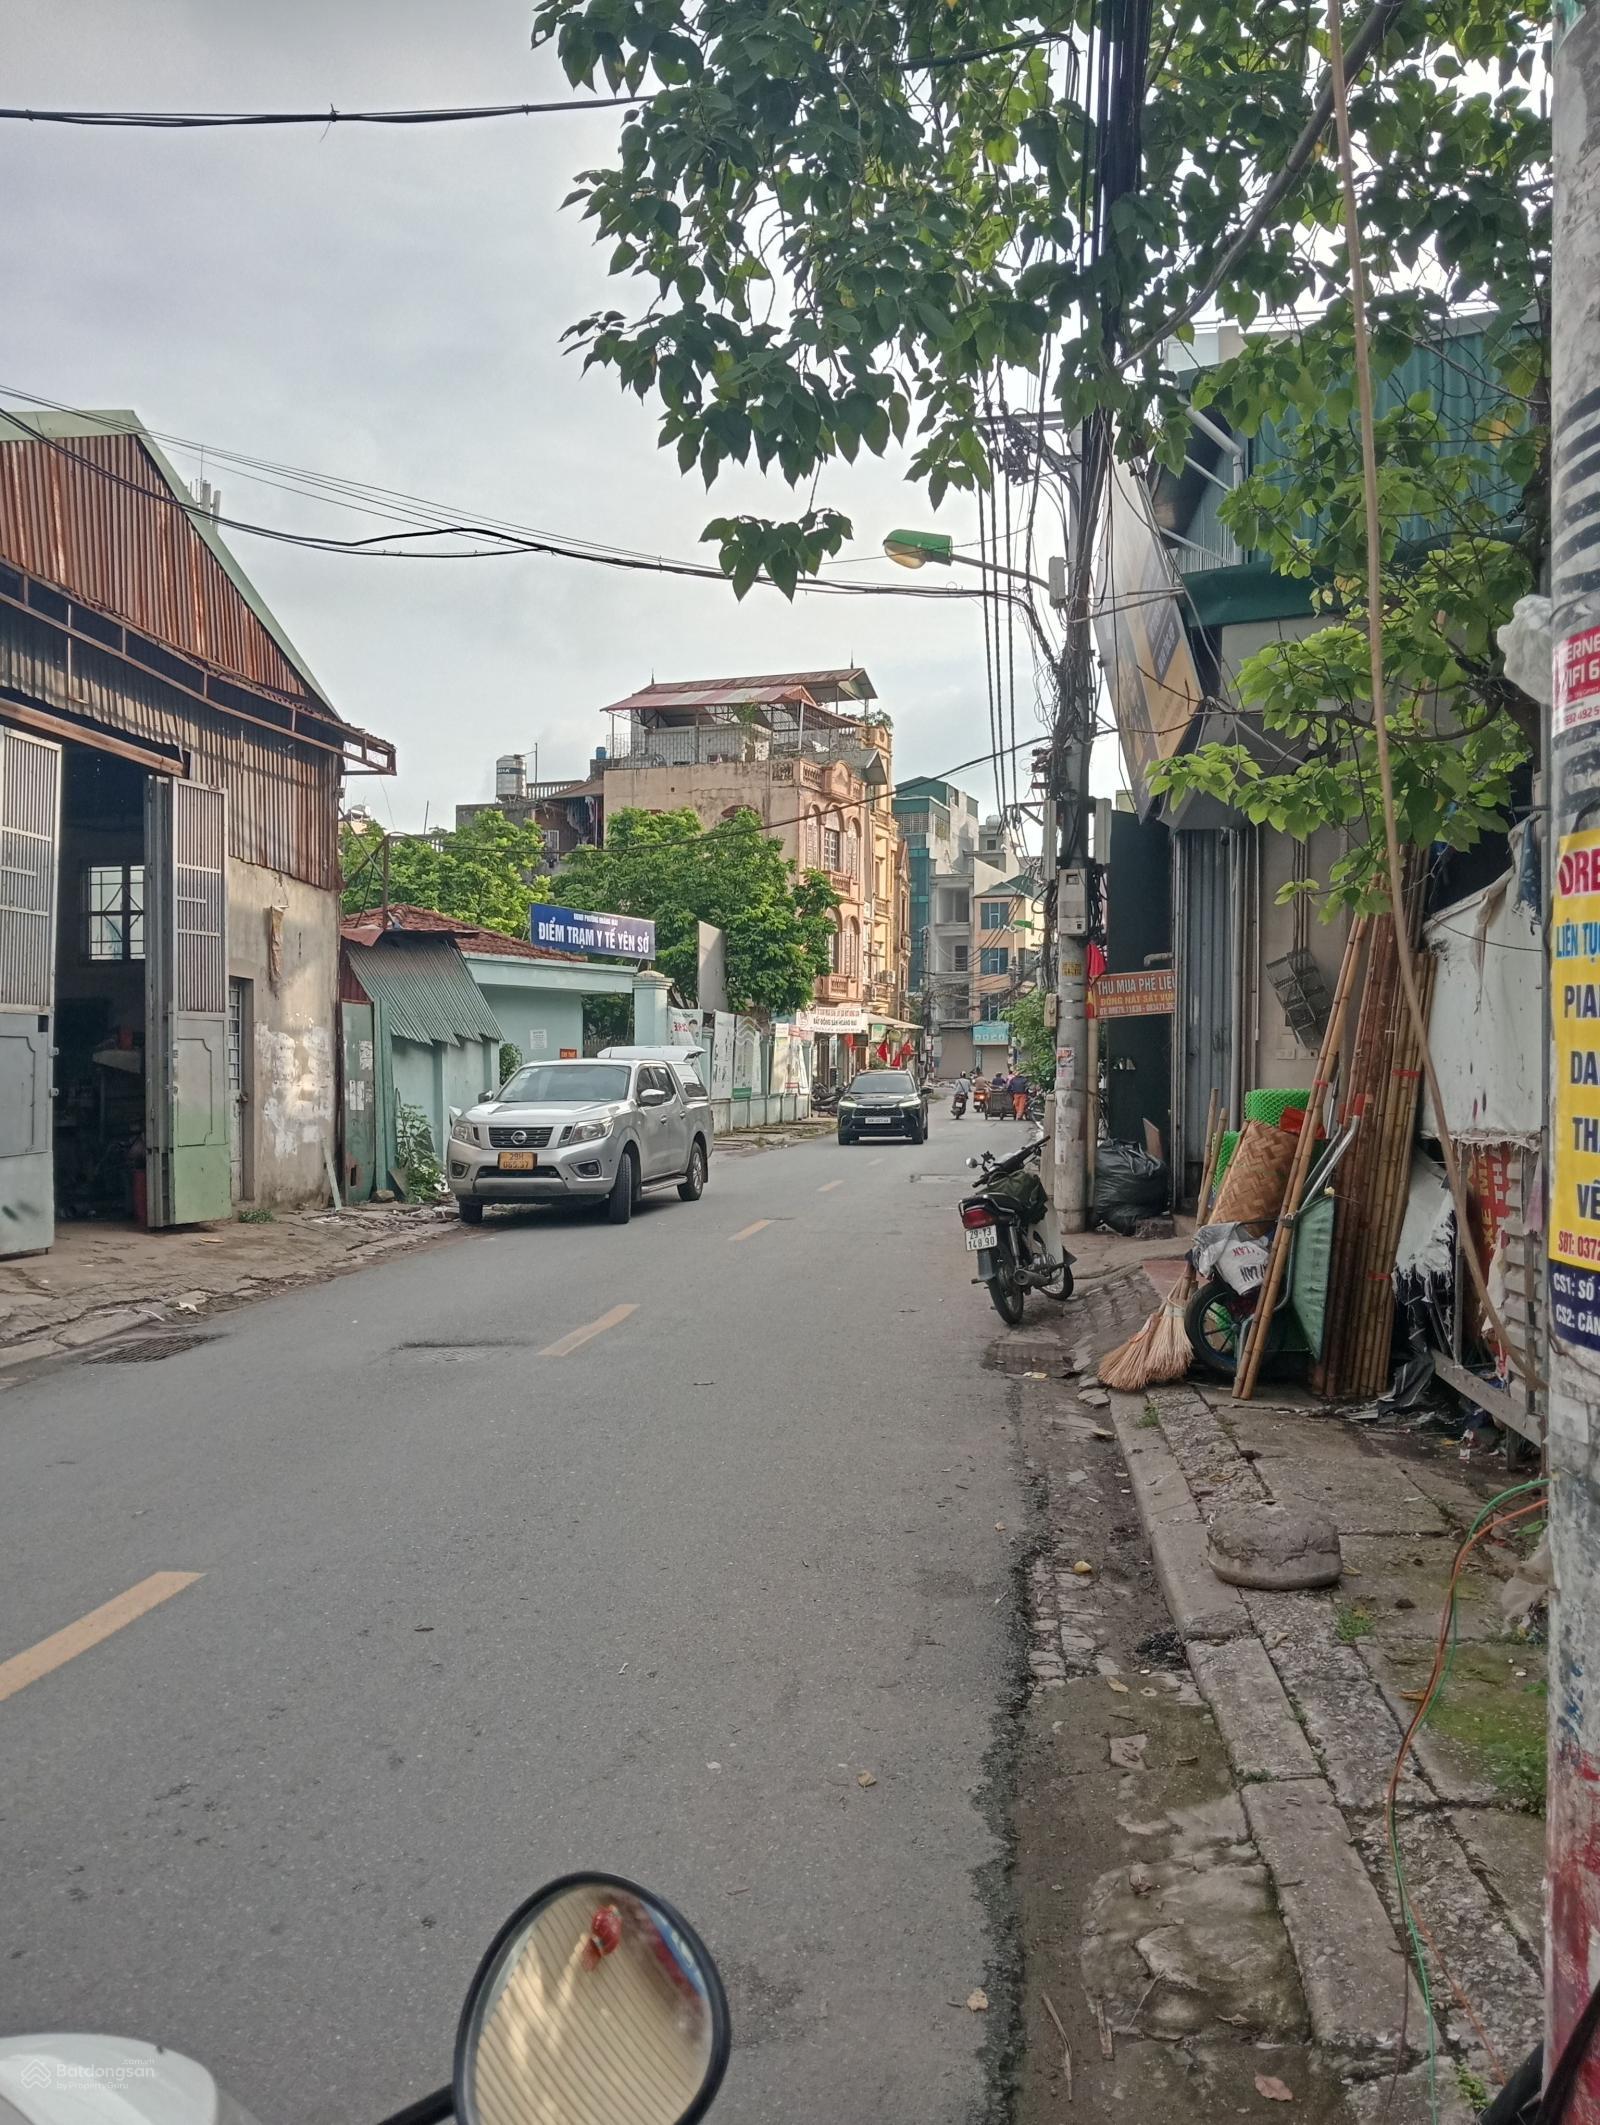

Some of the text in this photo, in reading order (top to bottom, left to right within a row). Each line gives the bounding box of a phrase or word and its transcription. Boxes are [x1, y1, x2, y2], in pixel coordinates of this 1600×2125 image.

[1589, 658, 1600, 681] 6
[538, 916, 650, 954] ĐIỂM TRẠM Y TẾ YÊN SỞ
[1556, 917, 1600, 964] LIÊN TỤ
[1096, 980, 1115, 996] THU
[1116, 978, 1137, 994] MUA
[1138, 974, 1157, 992] PHẾ
[1564, 984, 1600, 1019] PIA
[1571, 1051, 1600, 1086] DA
[1572, 1116, 1600, 1153] TH
[1553, 1272, 1595, 1302] CS1: SỐ
[1556, 1303, 1576, 1329] CS2:
